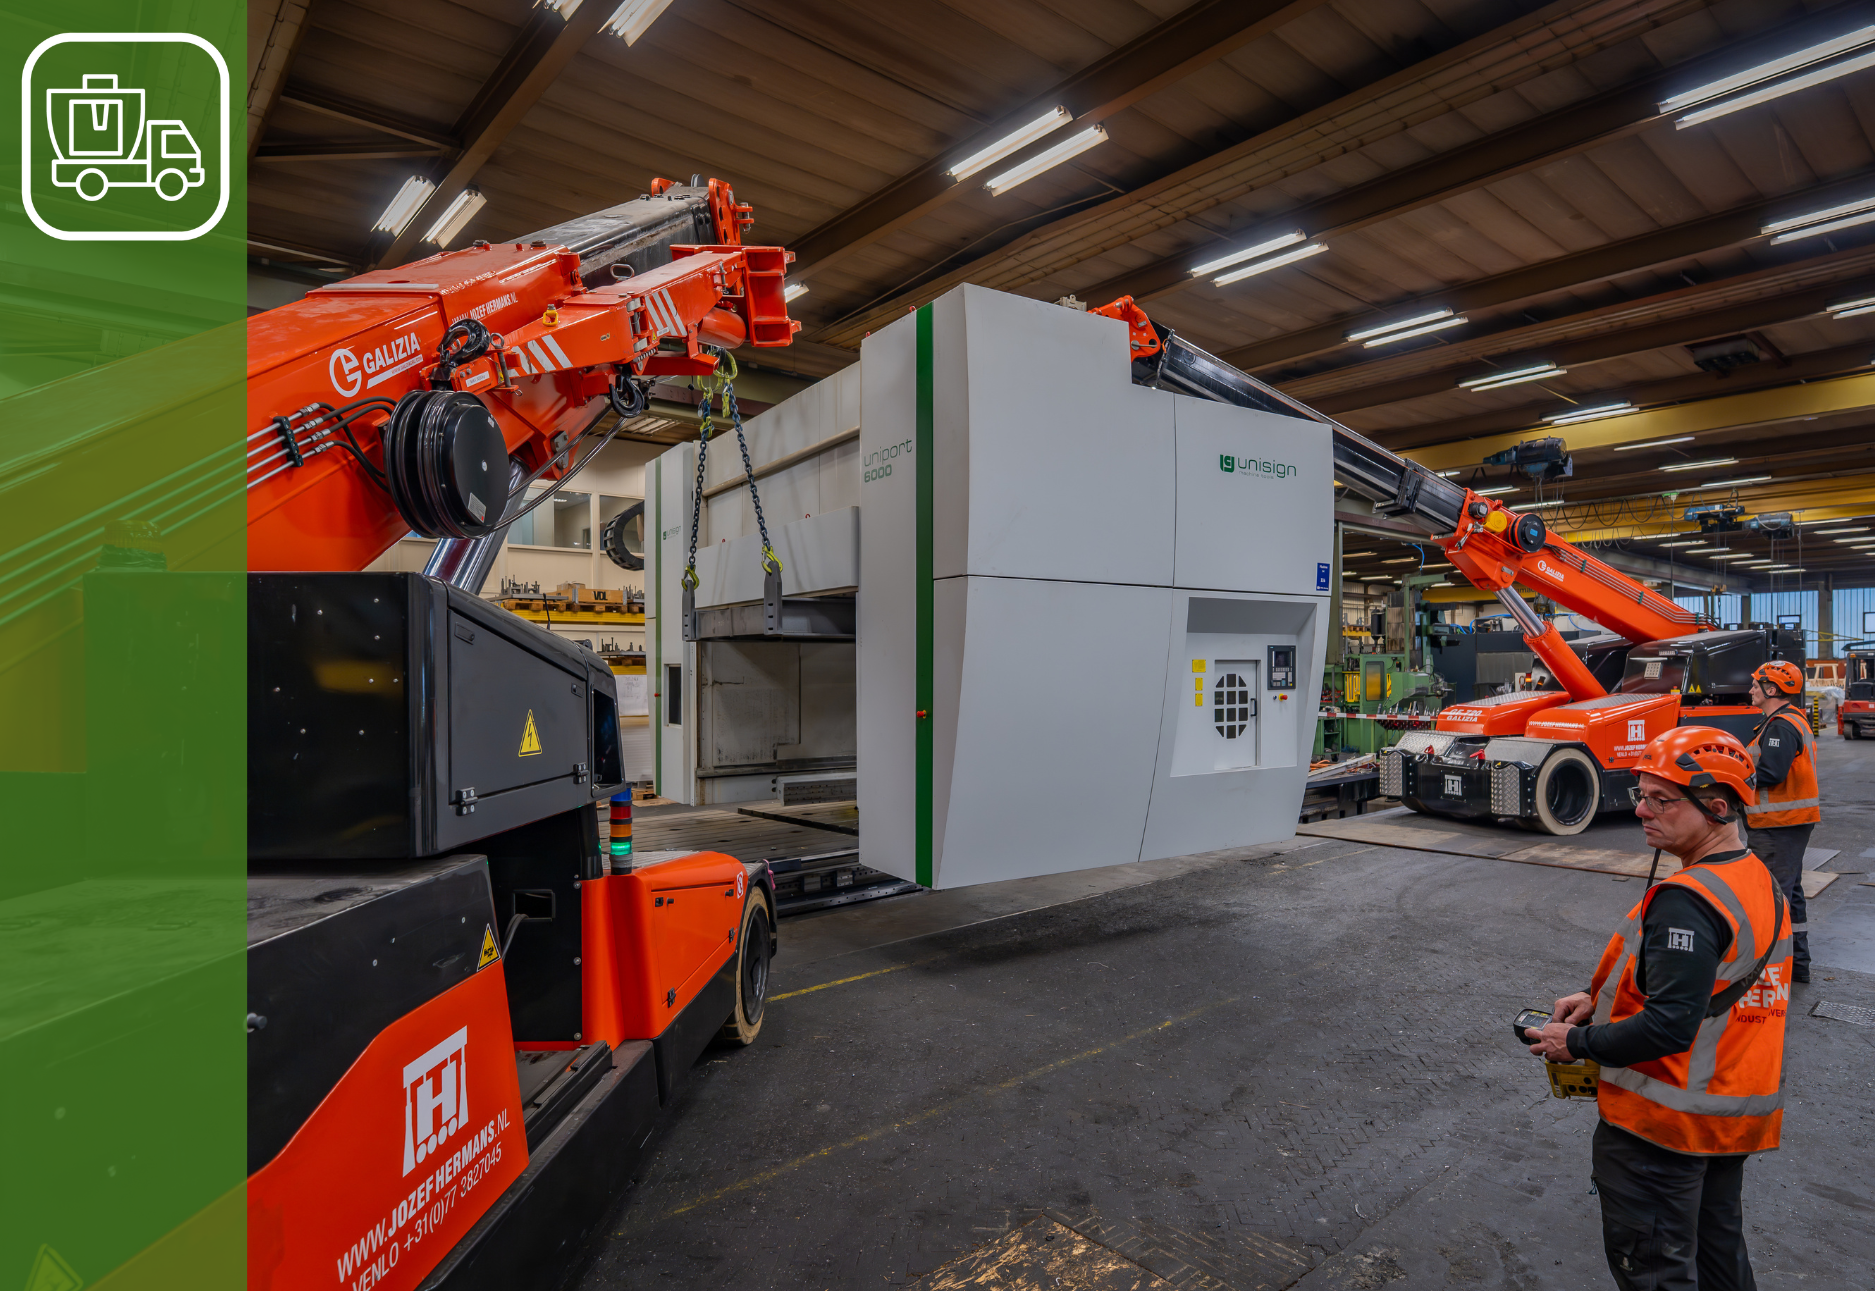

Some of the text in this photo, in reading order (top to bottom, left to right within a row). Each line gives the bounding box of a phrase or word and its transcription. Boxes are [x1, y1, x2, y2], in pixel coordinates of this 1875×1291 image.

[362, 332, 421, 374] GALIZIA
[863, 438, 913, 467] uniport
[863, 464, 892, 483] 6000
[1237, 457, 1297, 479] unisign
[1546, 567, 1565, 579] GALIZIA
[592, 590, 609, 601] VDL
[403, 1184, 457, 1252] +31(0)77
[460, 1141, 502, 1198] 3827045
